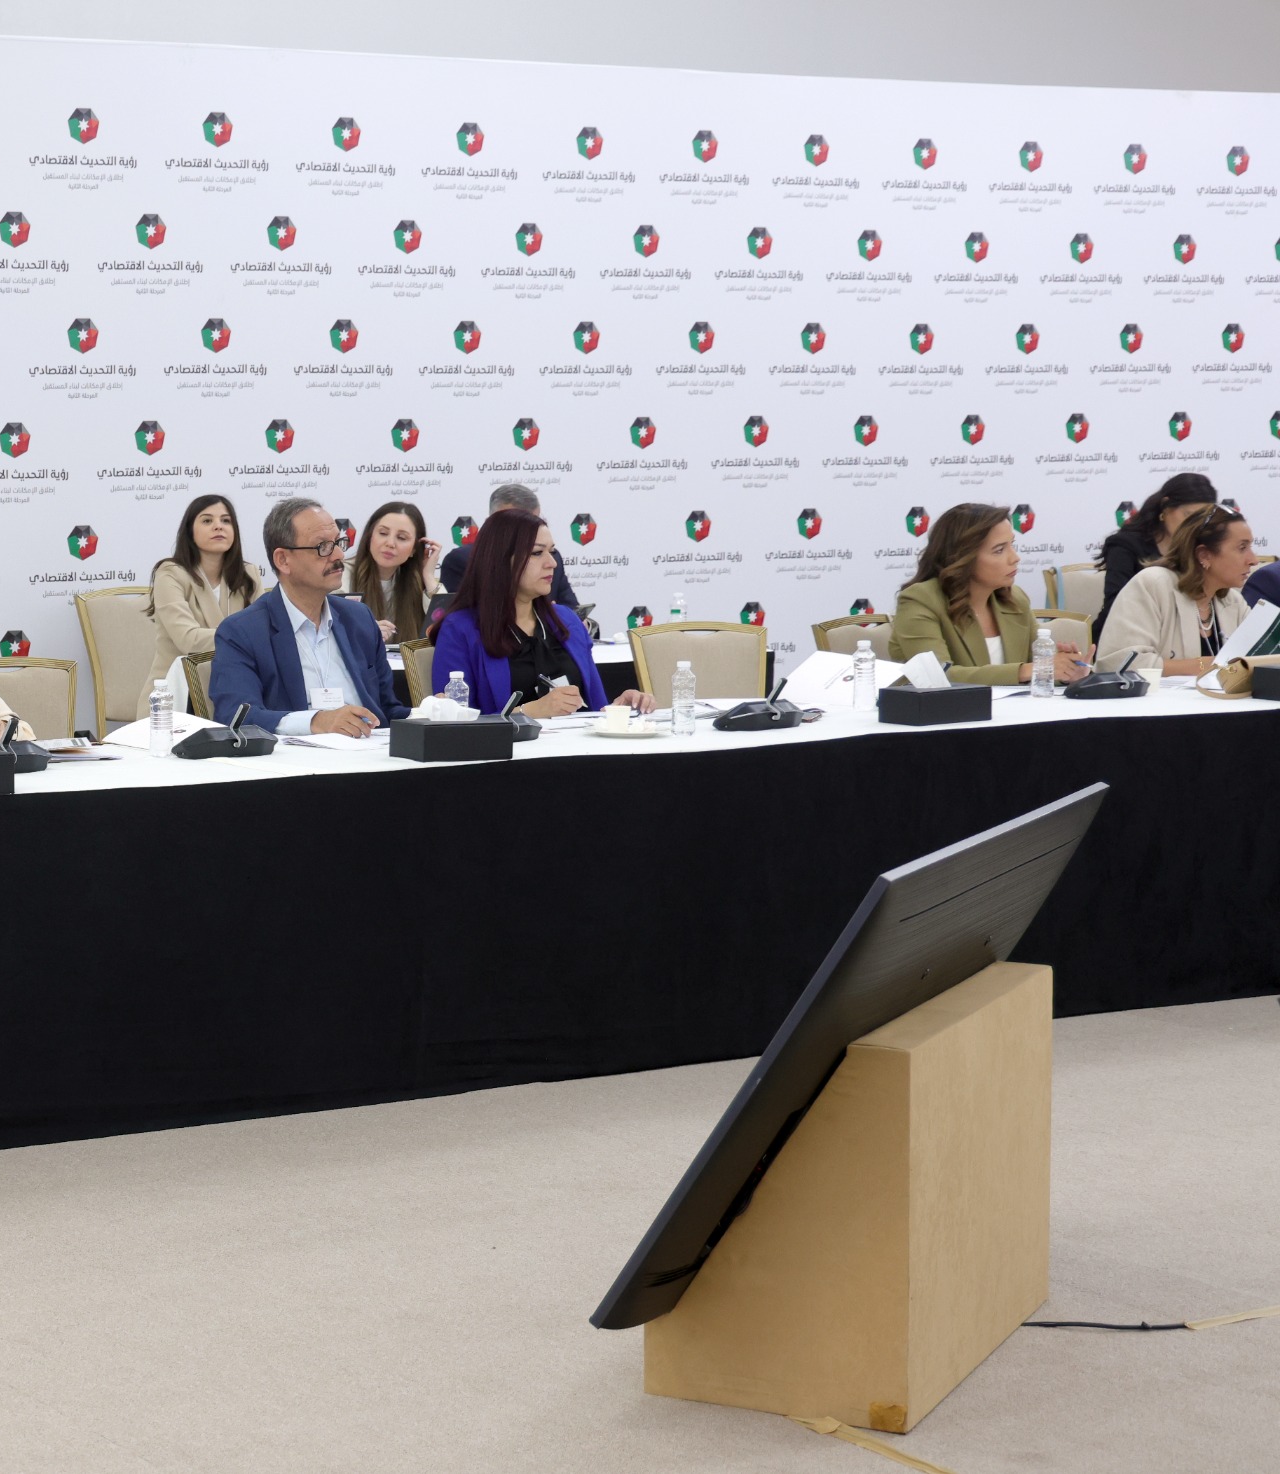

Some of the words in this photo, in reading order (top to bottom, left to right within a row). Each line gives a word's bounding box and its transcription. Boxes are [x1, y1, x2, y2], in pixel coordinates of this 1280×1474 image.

[29, 154, 77, 166] الاقتصادي
[80, 155, 117, 168] التحديث
[119, 156, 137, 169] رؤية
[295, 161, 340, 173] الاقتصادي
[343, 163, 377, 175] التحديث
[378, 164, 396, 176] رؤية
[98, 260, 145, 272] الاقتصادي
[148, 261, 183, 273] التحديث
[185, 261, 203, 273] رؤية
[29, 365, 77, 377] الاقتصادي
[79, 365, 116, 377] التحديث
[118, 364, 136, 377] رؤية
[11, 469, 48, 481] التحديث
[50, 469, 69, 481] رؤية
[29, 572, 77, 585] الاقتصادي
[79, 570, 115, 583] التحديث
[117, 569, 135, 582] رؤية
